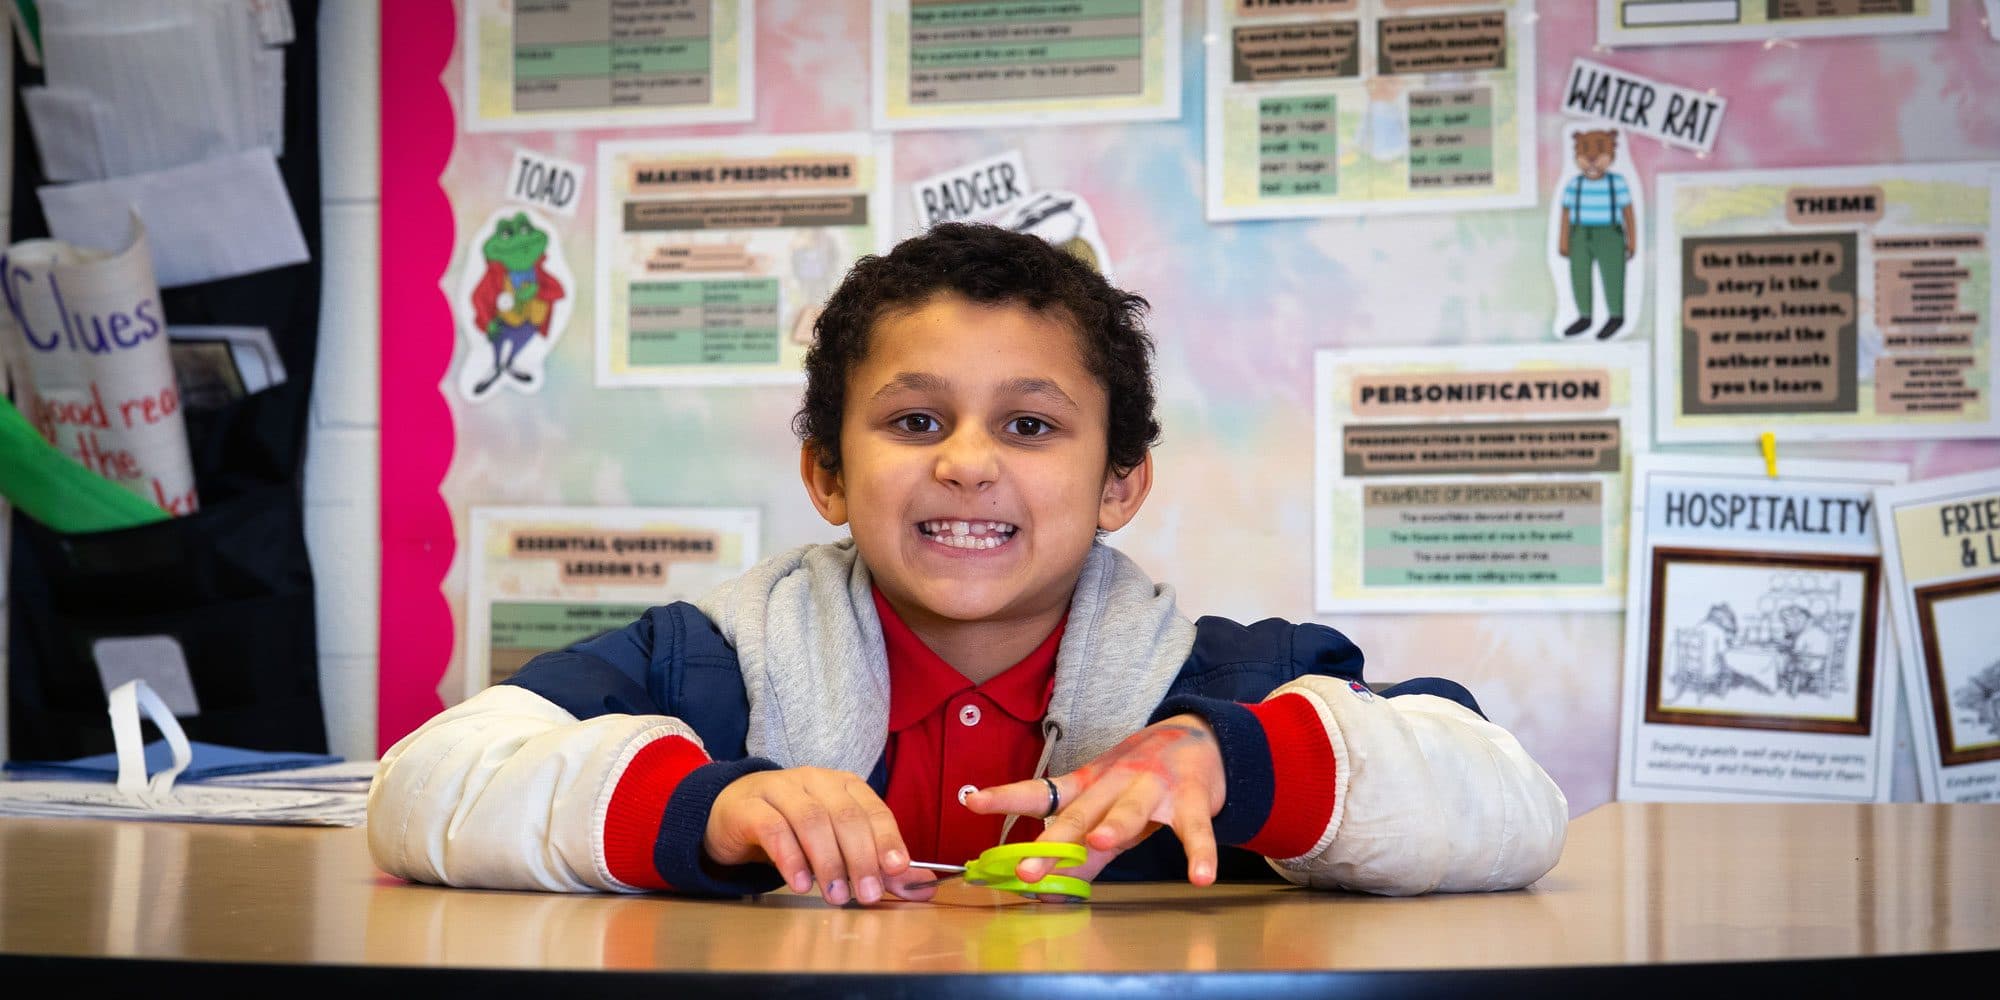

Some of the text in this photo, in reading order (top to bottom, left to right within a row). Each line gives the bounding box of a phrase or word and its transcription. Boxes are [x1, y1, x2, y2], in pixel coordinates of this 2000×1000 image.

[1567, 66, 1719, 144] WATER RAT
[515, 158, 576, 208] TOAD
[637, 164, 850, 185] MAKING PREDICTIONS
[922, 162, 1020, 226] BADGER
[1793, 195, 1878, 215] THEME
[1702, 249, 1835, 268] the theme of a
[1716, 274, 1820, 299] story is the
[1, 255, 160, 354] Clues
[1690, 301, 1847, 323] message, lesson,
[1711, 326, 1826, 344] or moral the
[1706, 352, 1830, 369] author wants
[1360, 381, 1601, 404] PERSONIFICATION
[1711, 377, 1824, 400] you to learn
[1665, 491, 1872, 535] HOSPITALITY
[1941, 499, 2000, 537] FRIE
[516, 535, 714, 554] ESSENTIAL QUESTIONS
[1962, 538, 1977, 568] &
[565, 560, 632, 577] LESSON
